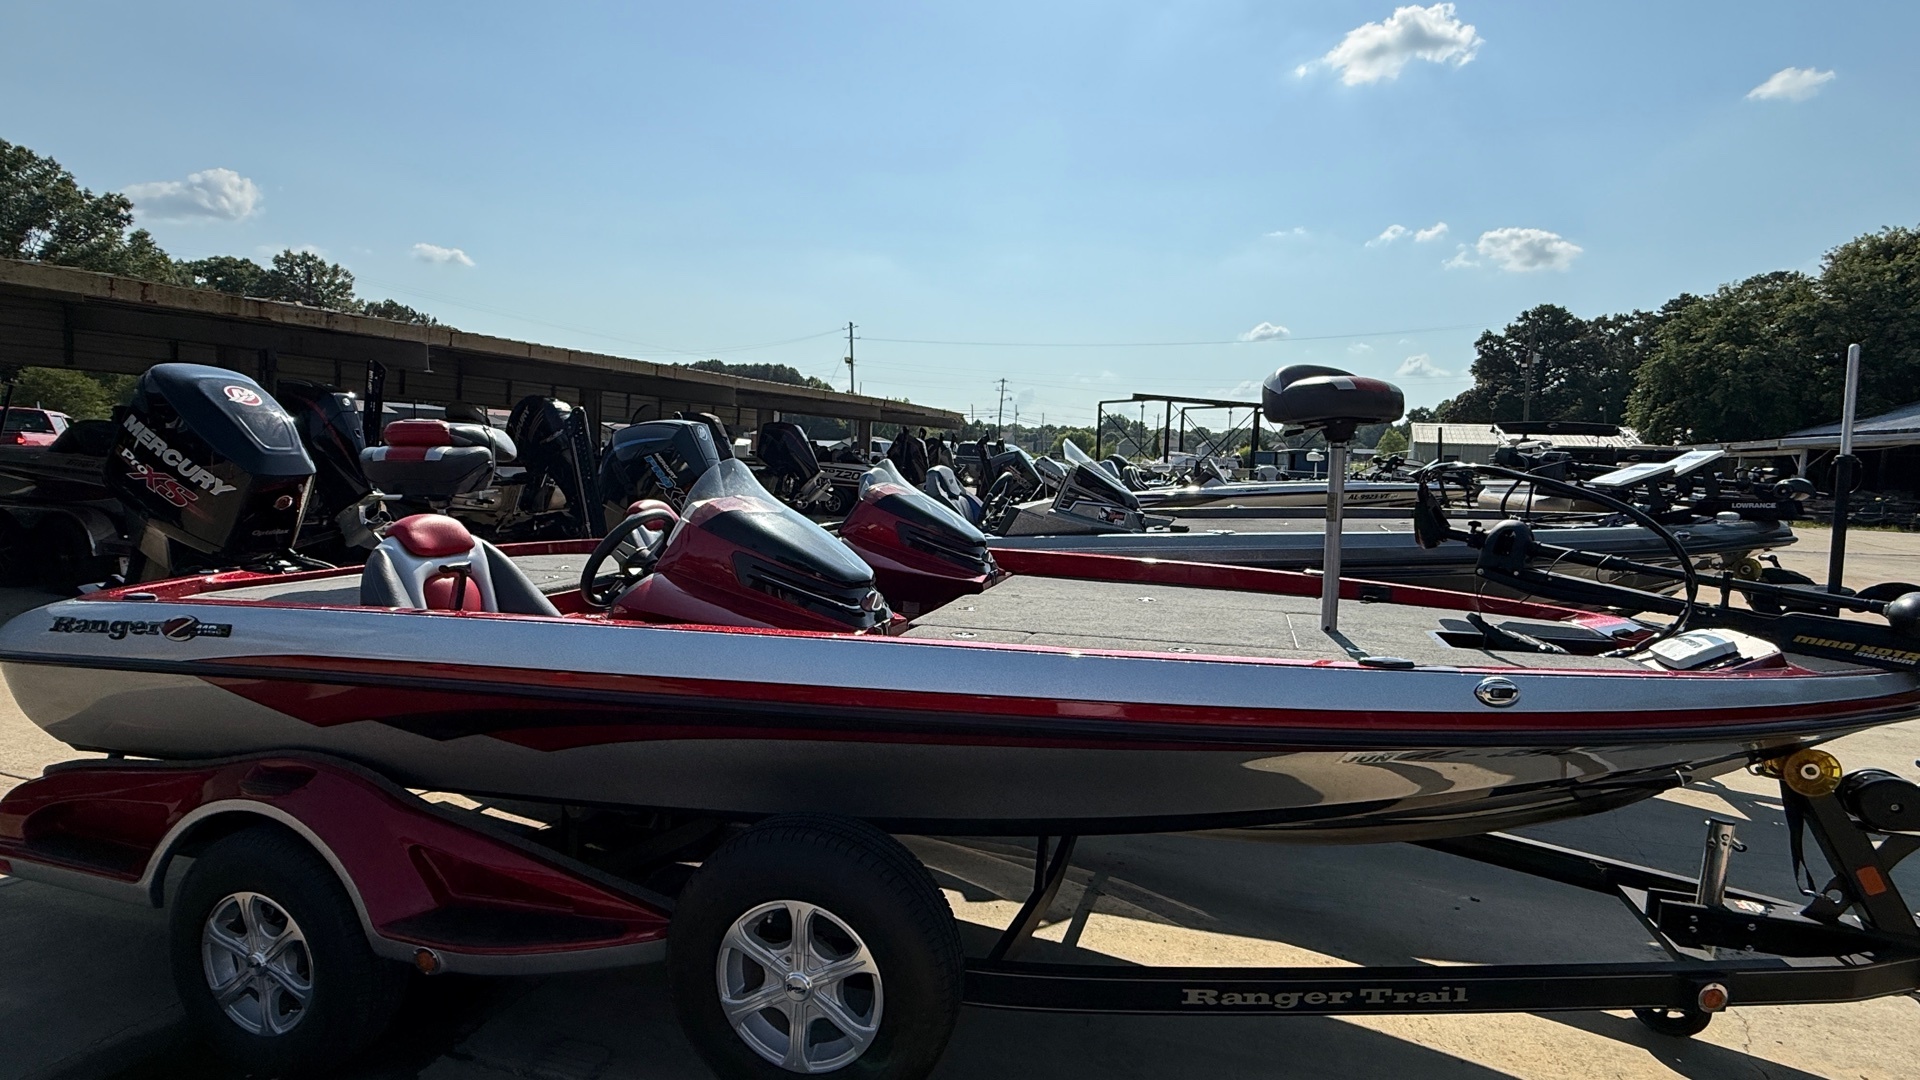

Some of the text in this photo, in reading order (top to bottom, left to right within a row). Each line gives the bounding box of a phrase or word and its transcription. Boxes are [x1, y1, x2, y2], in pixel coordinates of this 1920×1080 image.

[123, 413, 237, 496] MERCURY
[126, 463, 199, 508] XS
[48, 616, 163, 640] Ranger
[1181, 986, 1469, 1009] Ranger Trail
